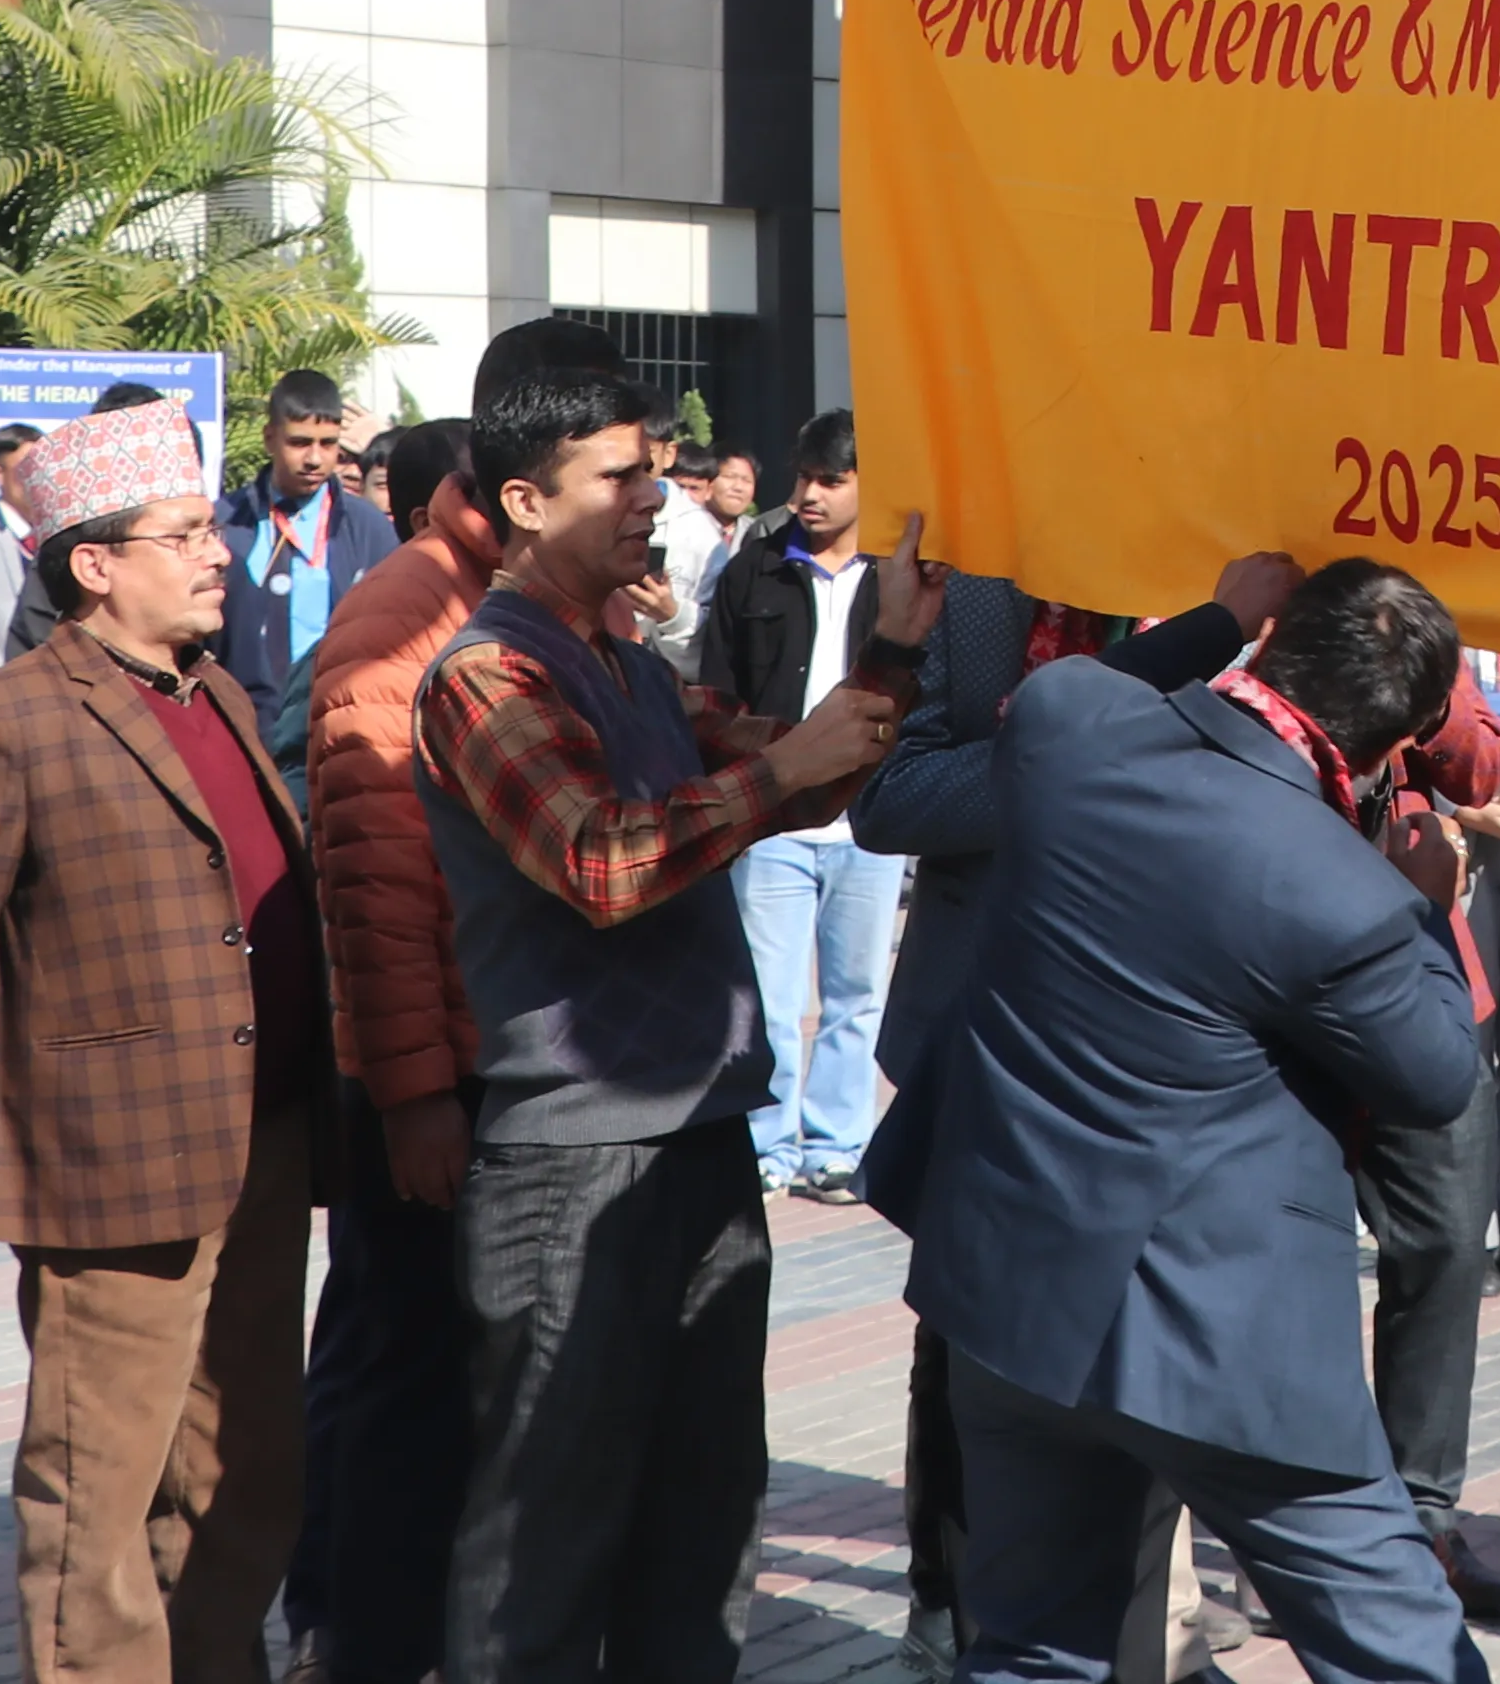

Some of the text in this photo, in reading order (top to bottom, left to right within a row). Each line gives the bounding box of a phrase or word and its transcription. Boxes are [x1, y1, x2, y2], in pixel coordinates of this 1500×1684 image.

[43, 358, 69, 372] the
[72, 359, 171, 377] Management
[174, 360, 193, 375] of
[35, 386, 107, 404] HERAL
